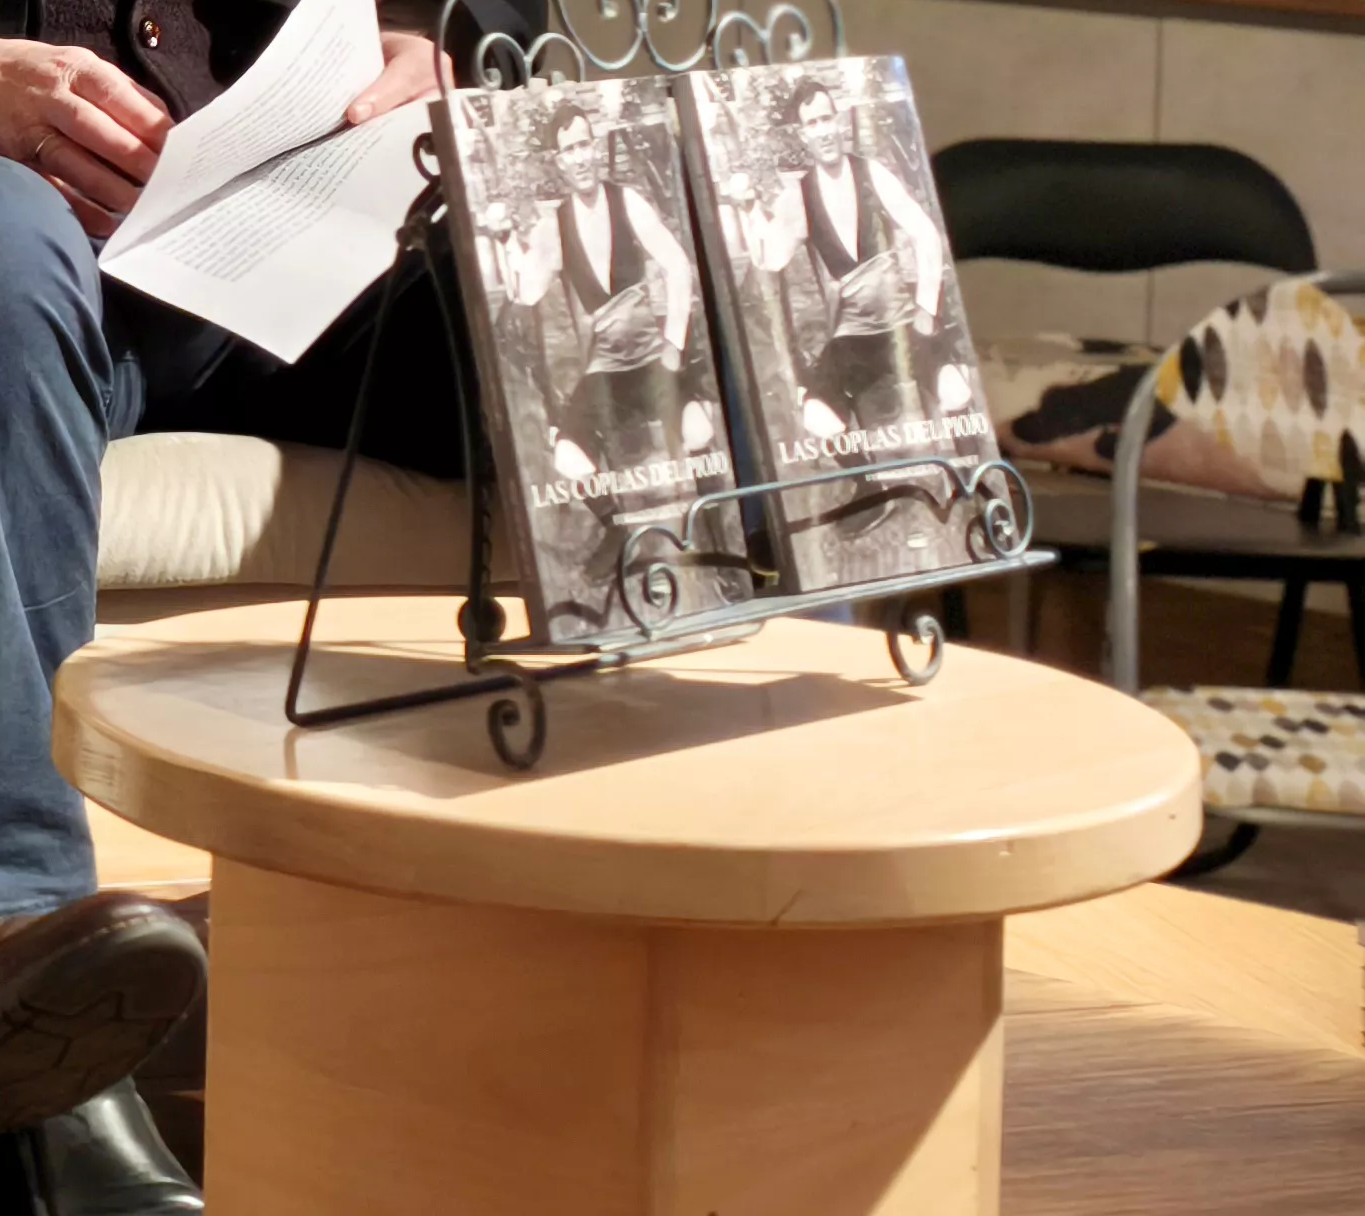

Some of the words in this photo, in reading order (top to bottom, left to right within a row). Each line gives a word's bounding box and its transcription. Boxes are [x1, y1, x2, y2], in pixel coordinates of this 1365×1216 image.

[777, 439, 819, 464] LAS
[821, 424, 902, 458] COPLAS
[903, 419, 941, 445] DEL
[531, 479, 570, 508] LAS
[571, 465, 648, 501] COPLAS
[648, 459, 682, 488] DEL
